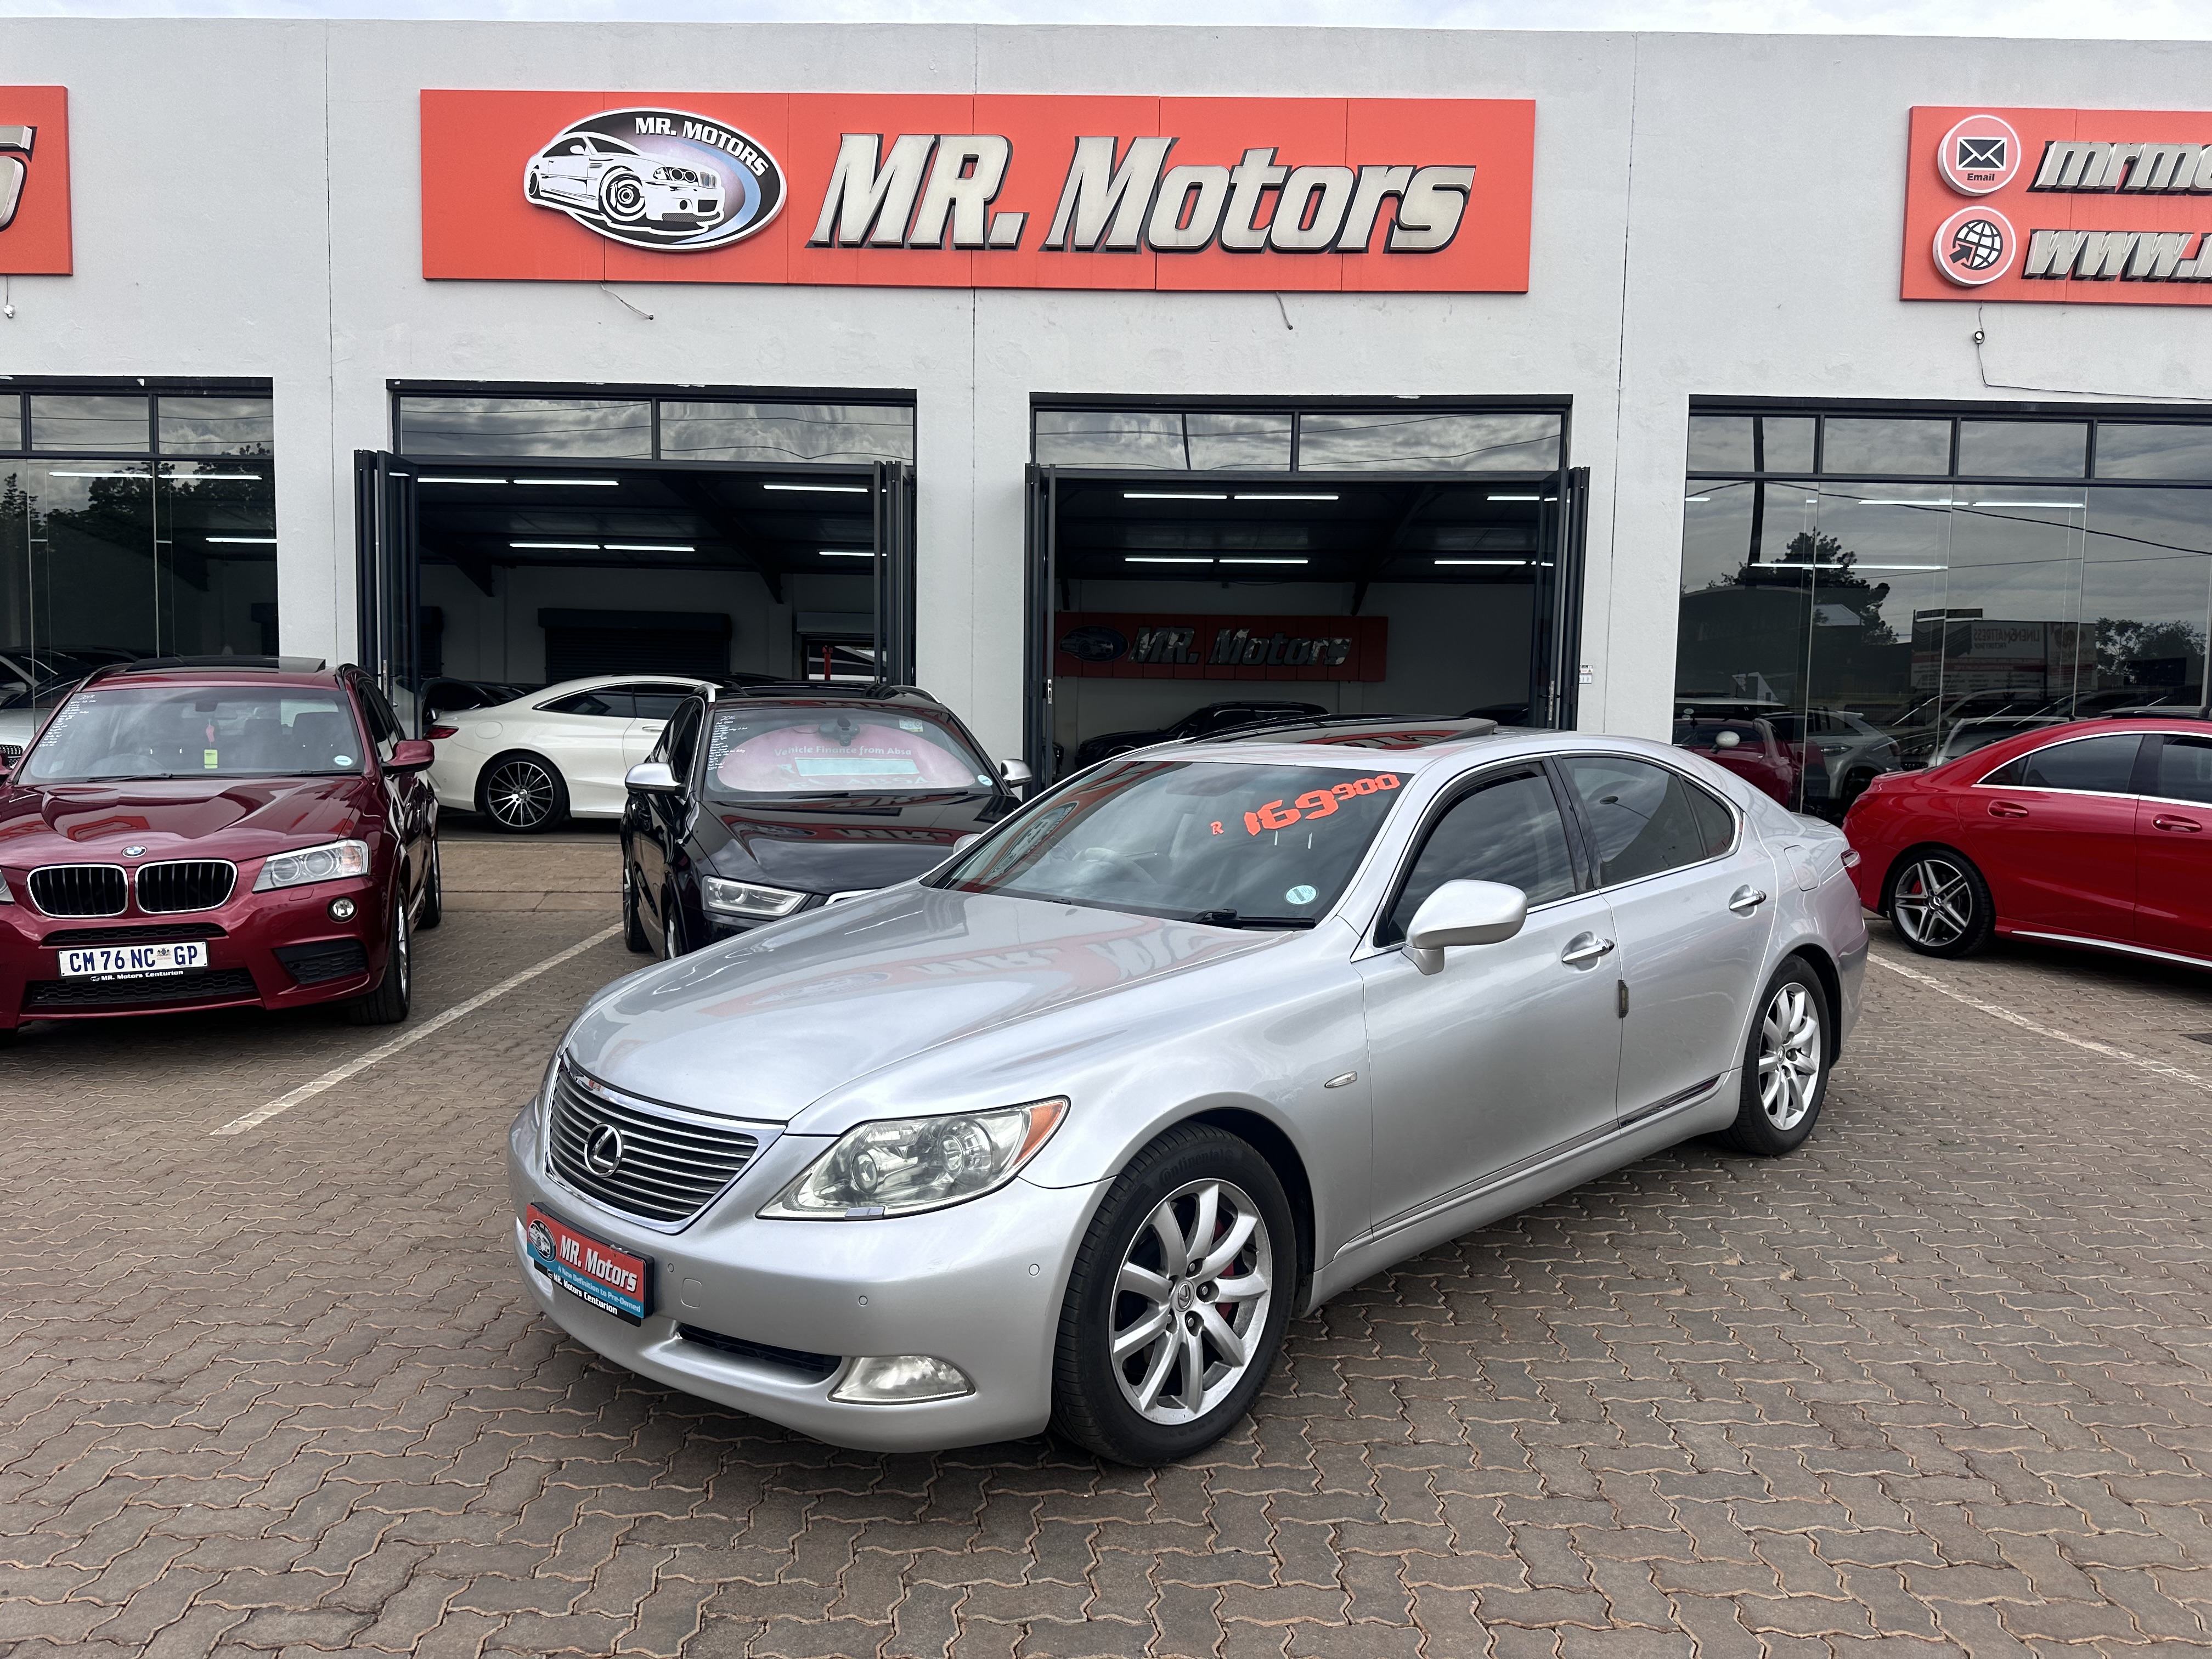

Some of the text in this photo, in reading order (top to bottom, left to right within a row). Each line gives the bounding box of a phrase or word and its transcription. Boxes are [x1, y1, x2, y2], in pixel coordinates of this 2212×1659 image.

[635, 117, 769, 177] MR. MOTORS
[806, 133, 1476, 253] MR. Motors
[1967, 173, 1995, 182] Email
[1127, 627, 1352, 666] MR. Motors
[774, 746, 813, 757] Vehicle
[859, 746, 884, 755] from
[1210, 821, 1224, 836] R
[69, 945, 198, 972] CM 76 NC GP
[145, 970, 184, 978] Centurion
[560, 1234, 638, 1293] MR. Motors
[553, 1272, 618, 1315] MR. Motors Centurion
[557, 1265, 641, 1313] A New Definition to Pre-Owned
